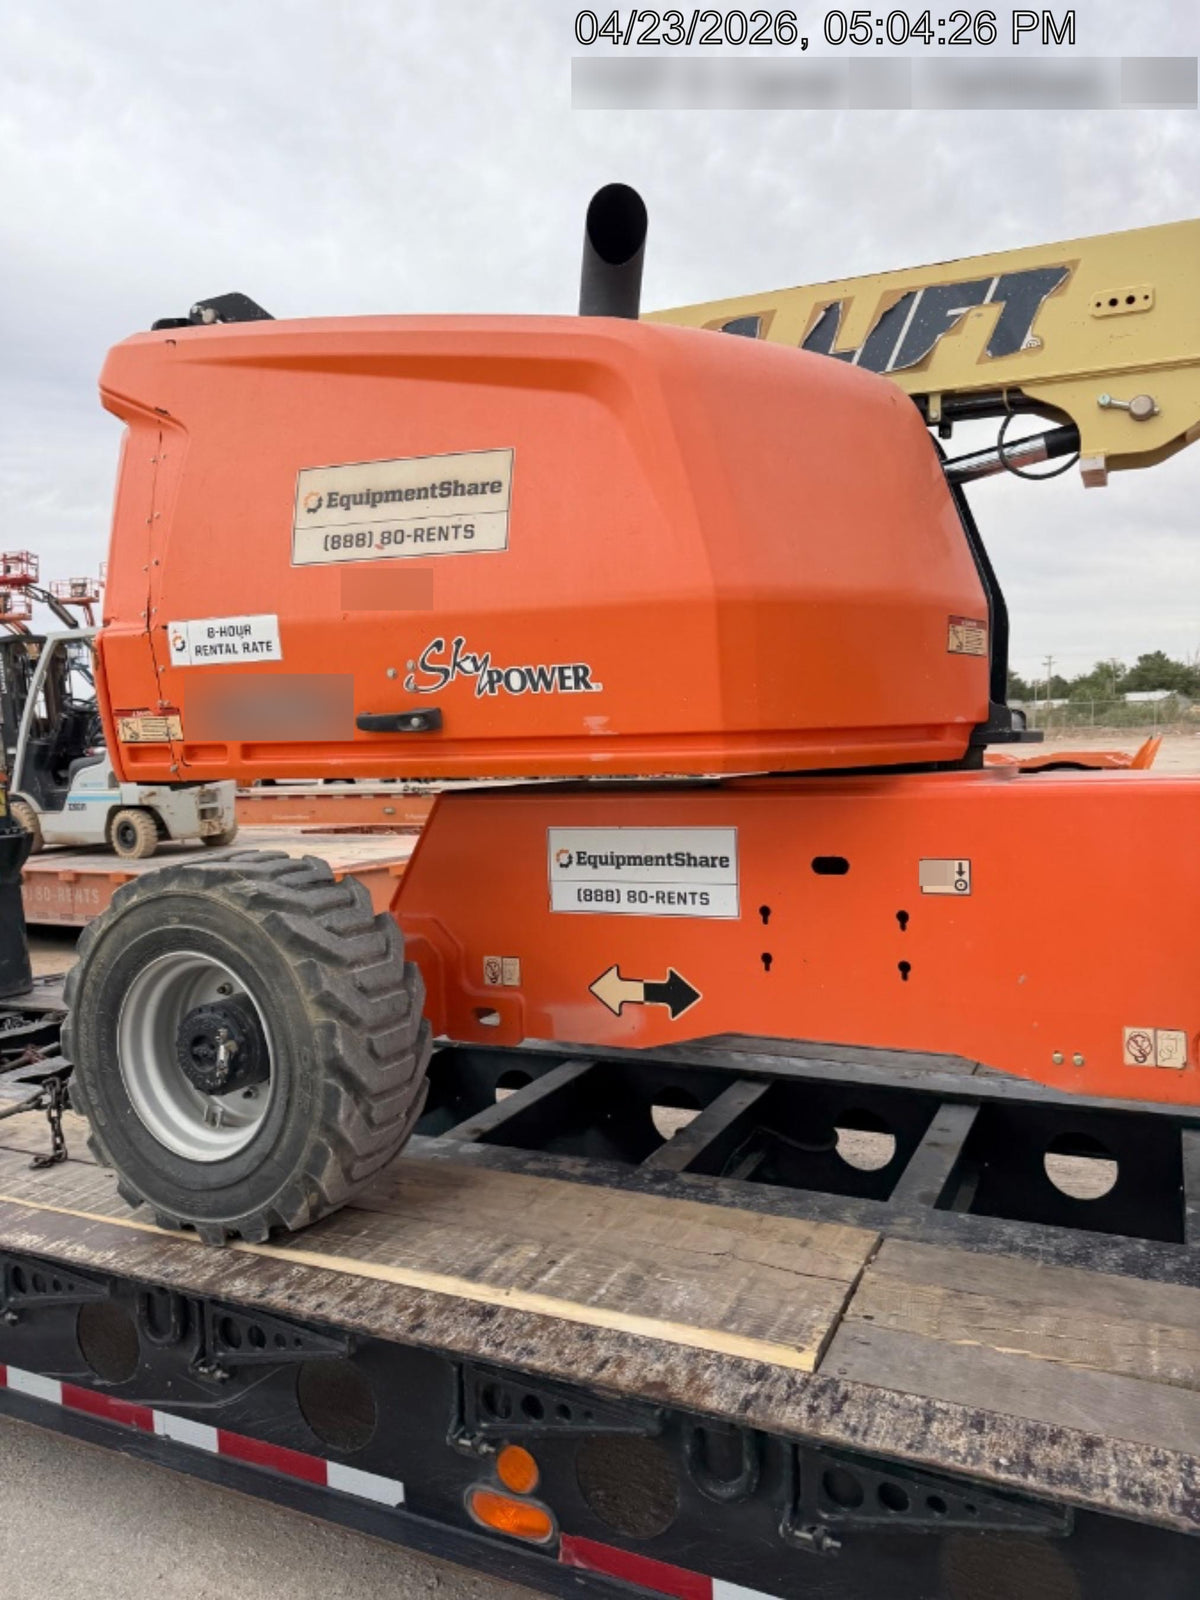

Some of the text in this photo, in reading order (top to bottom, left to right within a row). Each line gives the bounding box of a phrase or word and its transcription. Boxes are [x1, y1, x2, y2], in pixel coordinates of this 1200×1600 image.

[326, 479, 503, 512] EquipmentShare
[323, 524, 475, 552] (888) 80-RENTS
[207, 624, 252, 640] 8-HOUR
[194, 640, 273, 657] RENTAL RATE
[575, 851, 730, 870] EquipmentShare
[576, 888, 710, 906] (888) 80-RENTS
